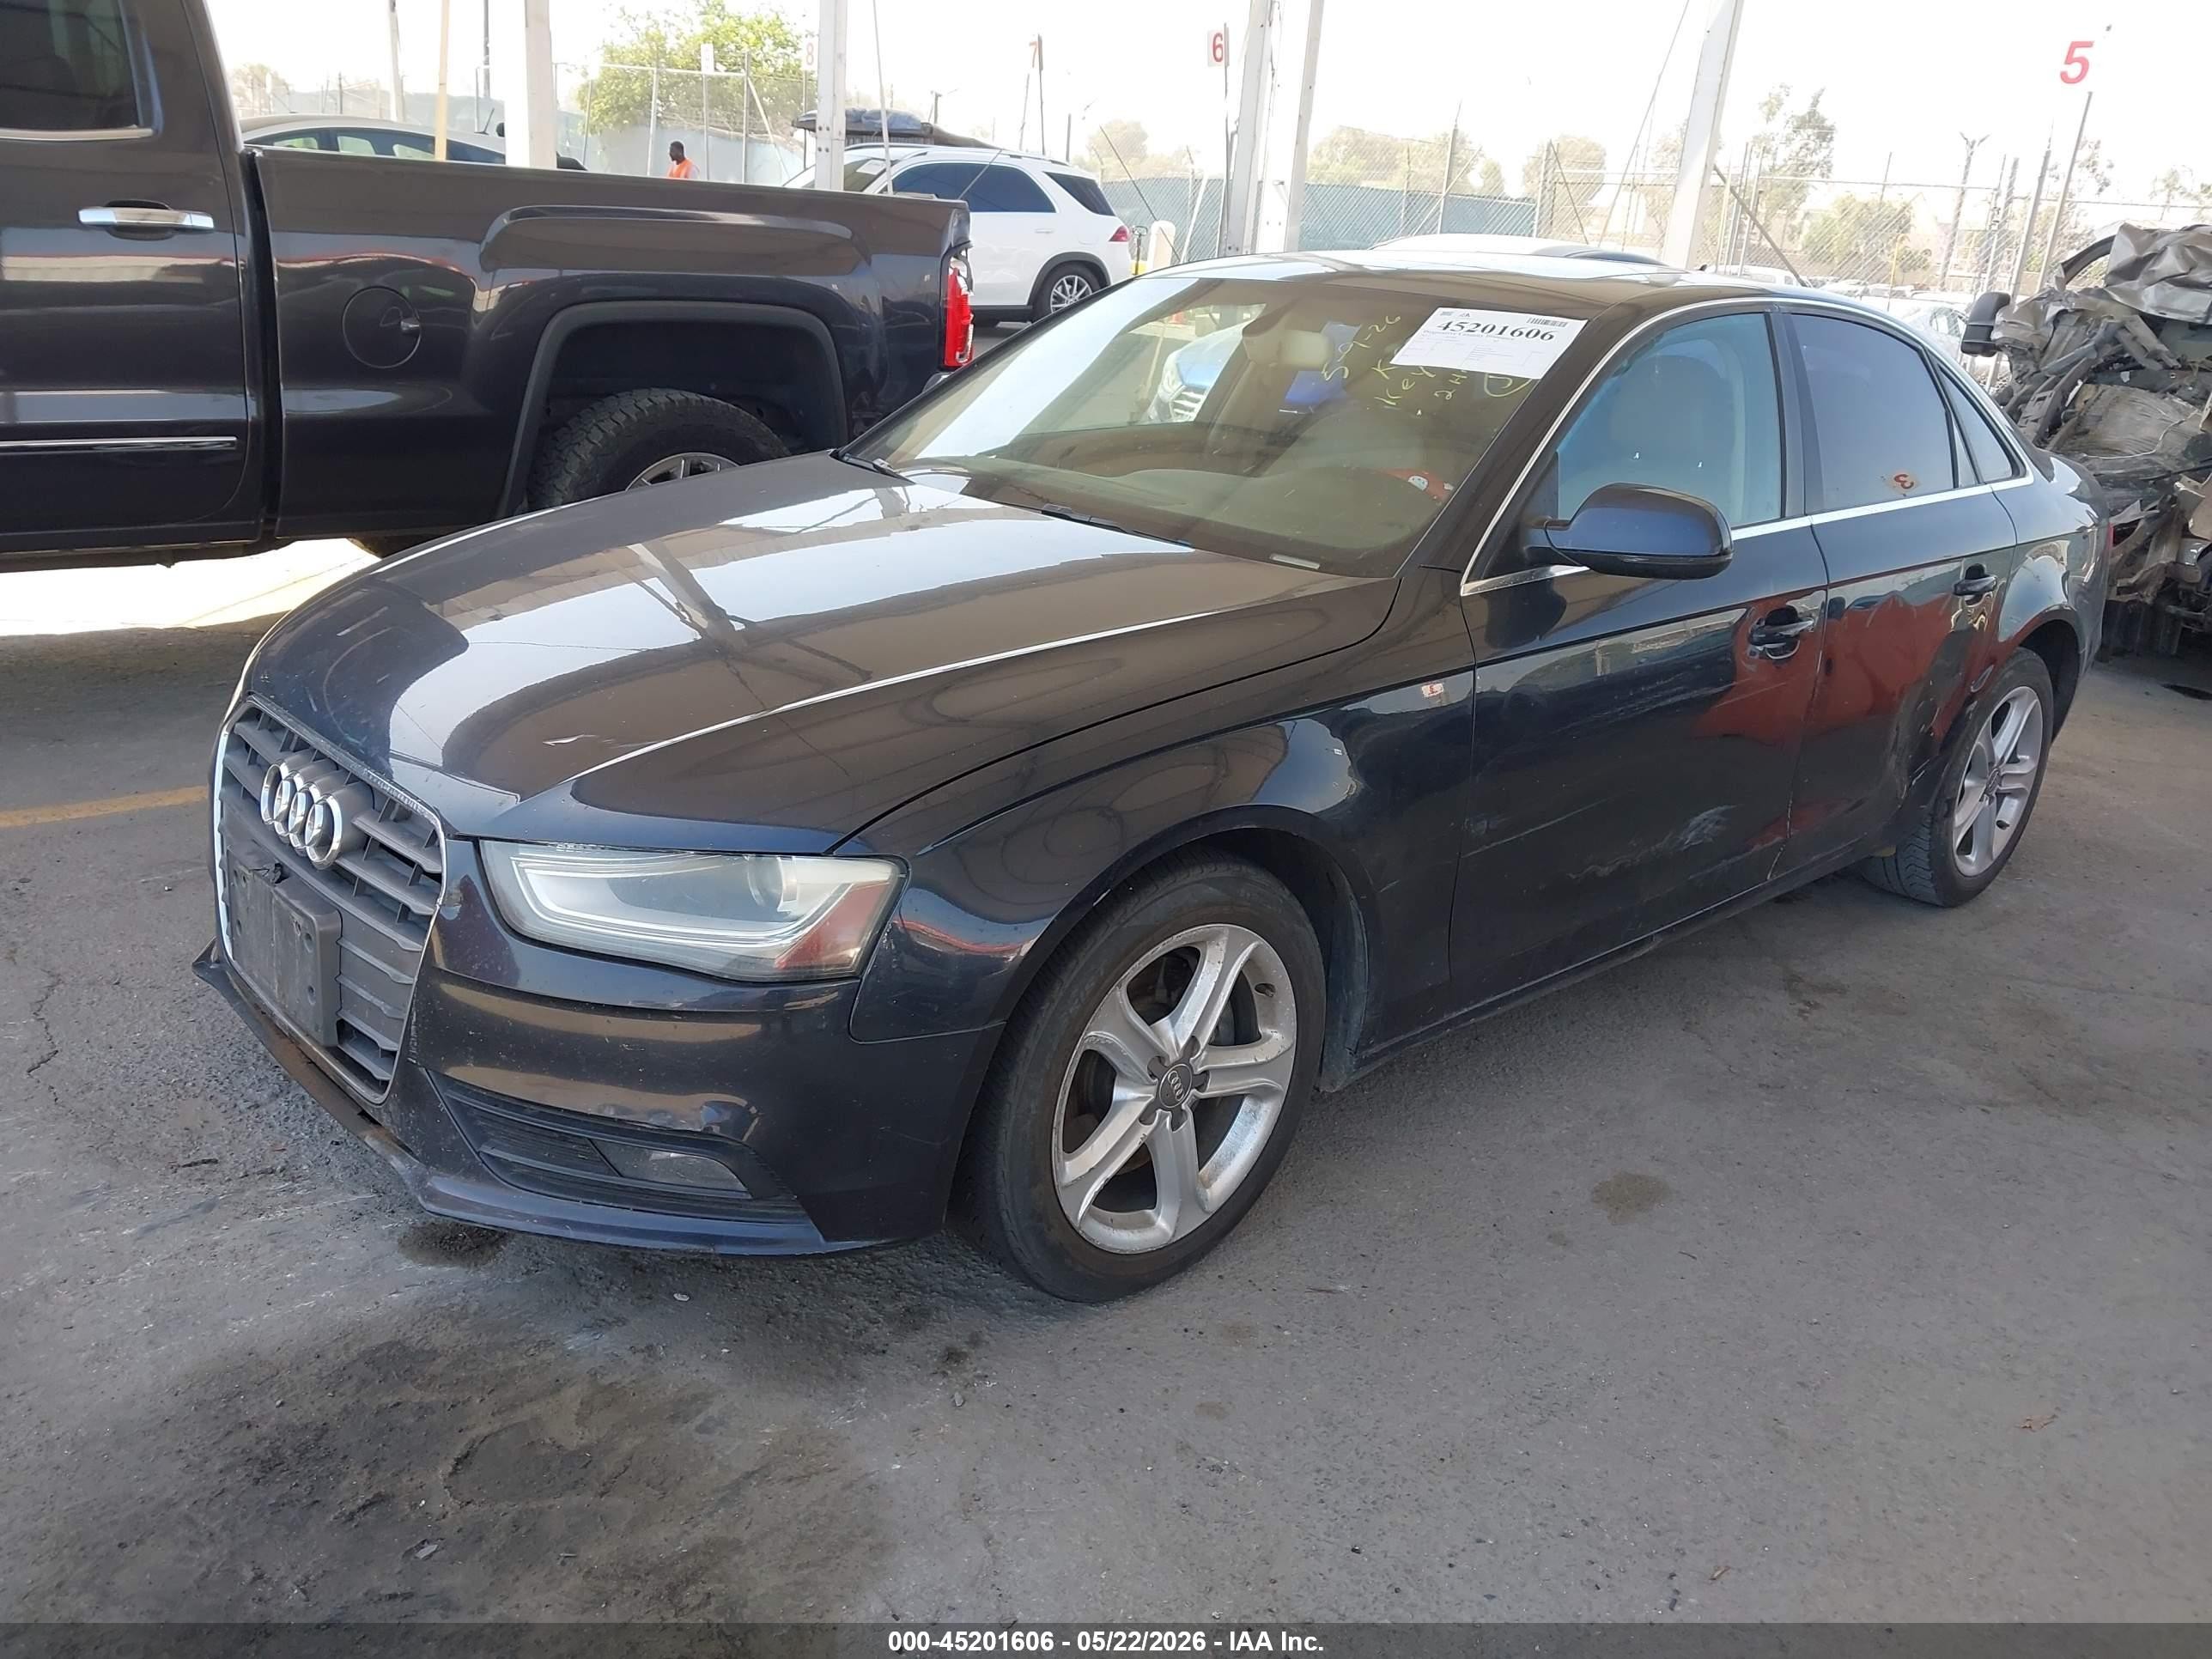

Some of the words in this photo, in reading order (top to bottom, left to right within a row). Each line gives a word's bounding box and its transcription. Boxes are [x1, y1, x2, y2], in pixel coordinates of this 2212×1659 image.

[805, 42, 814, 66] 8
[1029, 40, 1038, 69] 7
[1212, 32, 1224, 63] 6
[2059, 40, 2094, 84] 5
[1437, 320, 1559, 342] 45201606
